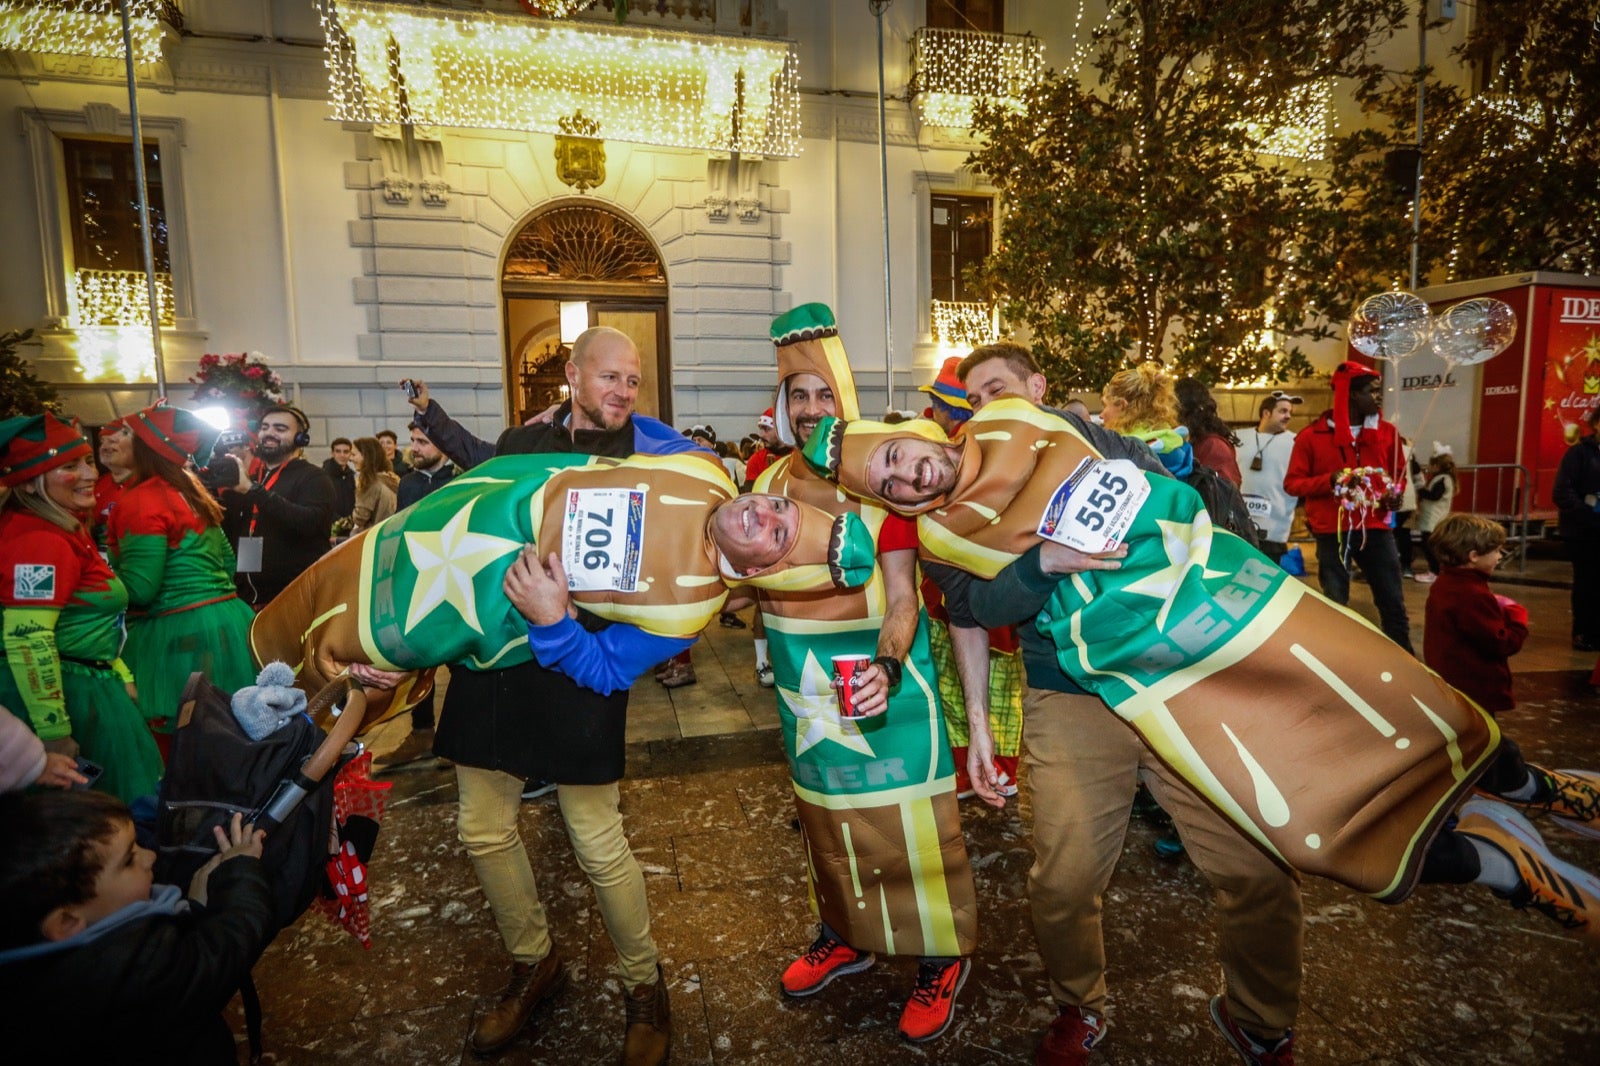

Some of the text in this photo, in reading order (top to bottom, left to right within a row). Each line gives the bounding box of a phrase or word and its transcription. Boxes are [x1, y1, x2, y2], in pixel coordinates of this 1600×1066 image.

[1402, 372, 1456, 388] IDEAL
[1484, 385, 1519, 396] IDEAL
[1075, 471, 1128, 531] 555
[1245, 502, 1268, 511] 095
[583, 508, 613, 570] 706
[1128, 558, 1280, 675] BEER
[792, 757, 909, 789] EER
